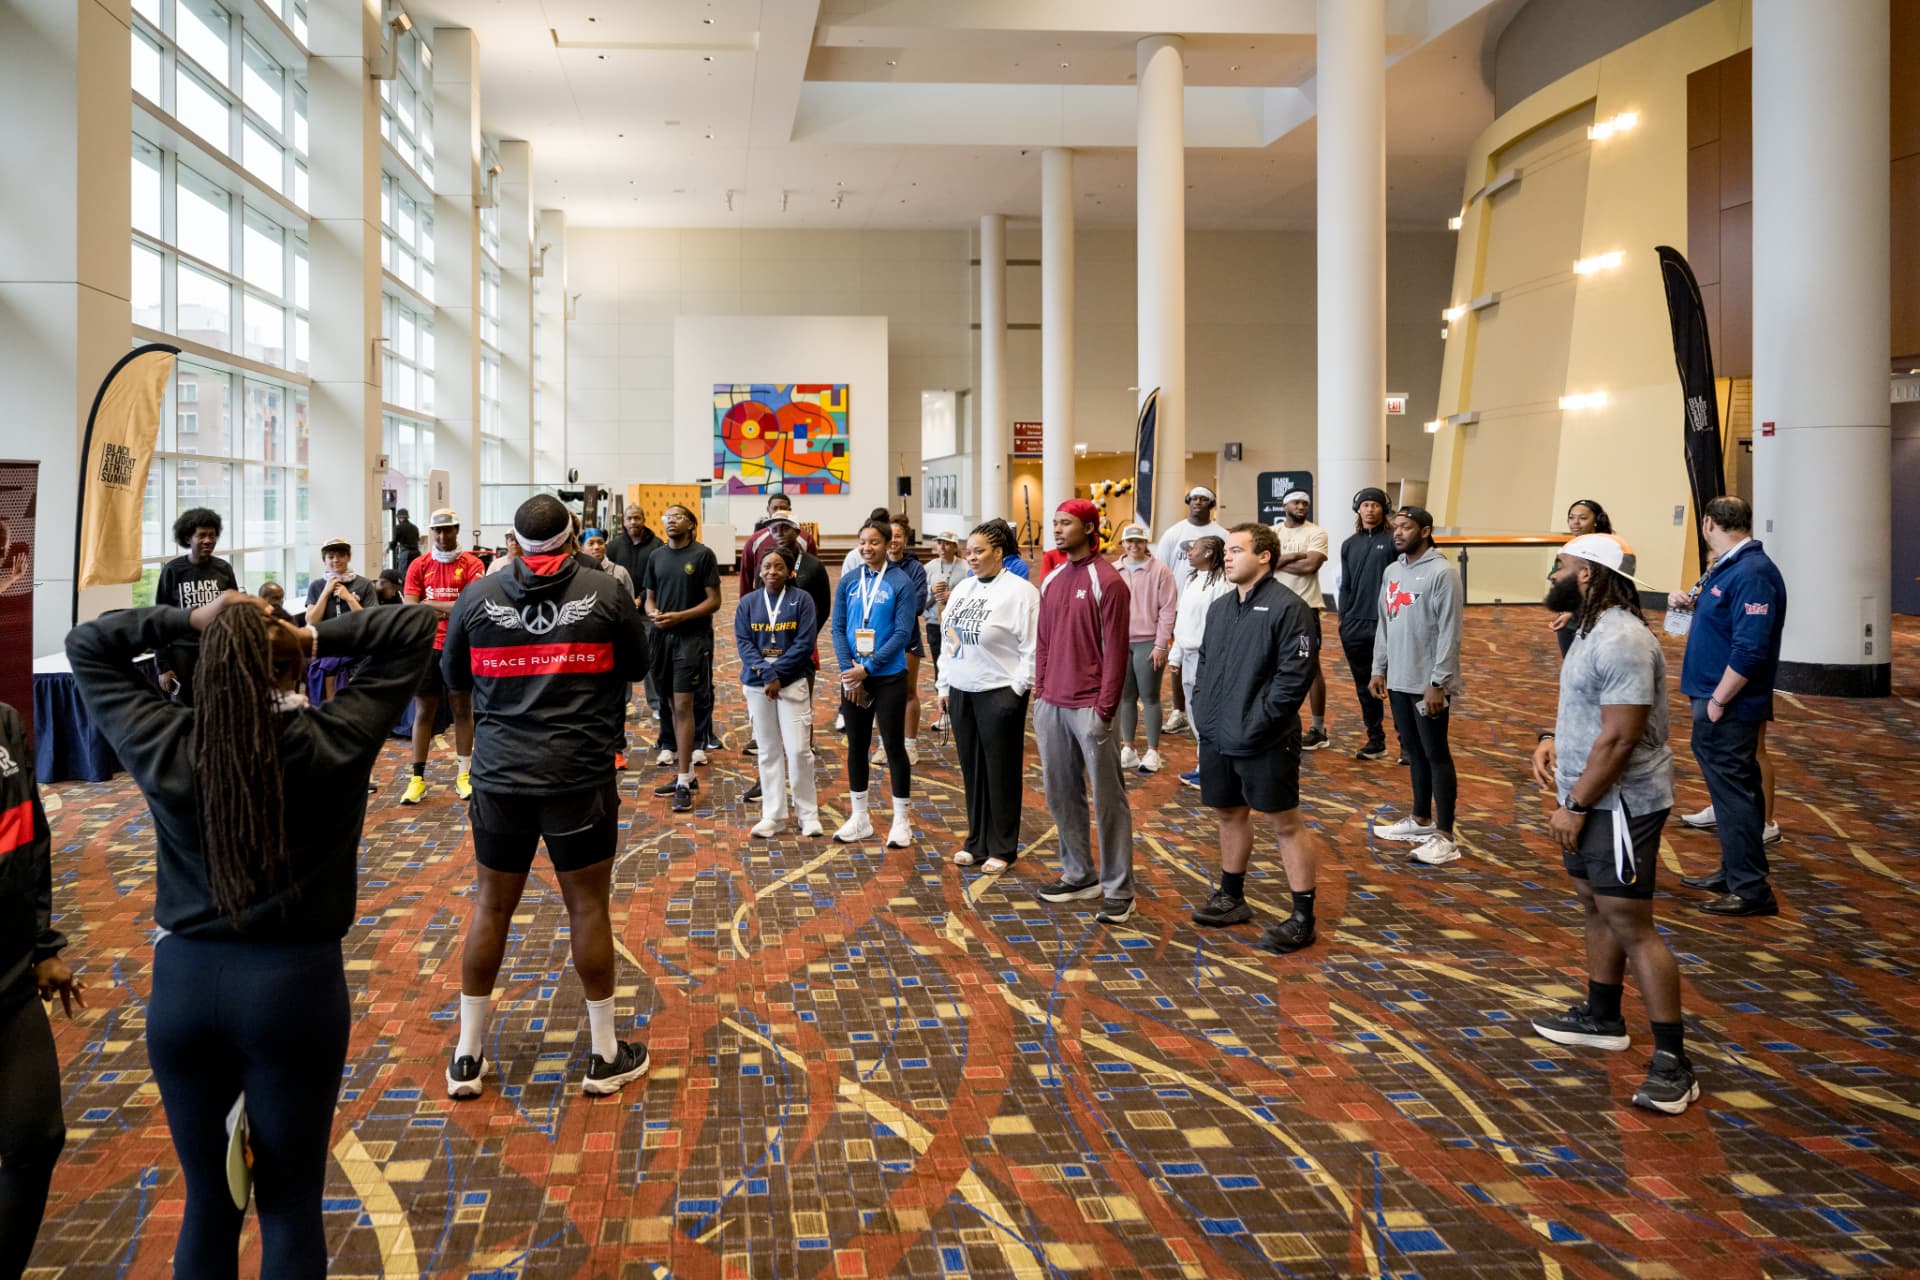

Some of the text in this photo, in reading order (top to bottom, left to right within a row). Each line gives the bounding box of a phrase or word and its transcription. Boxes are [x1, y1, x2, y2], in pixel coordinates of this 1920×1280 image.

[183, 580, 219, 594] BLACK
[955, 598, 987, 608] BCK
[765, 621, 797, 632] HGHER
[483, 658, 526, 668] PEACE
[531, 654, 596, 665] RUNNERS
